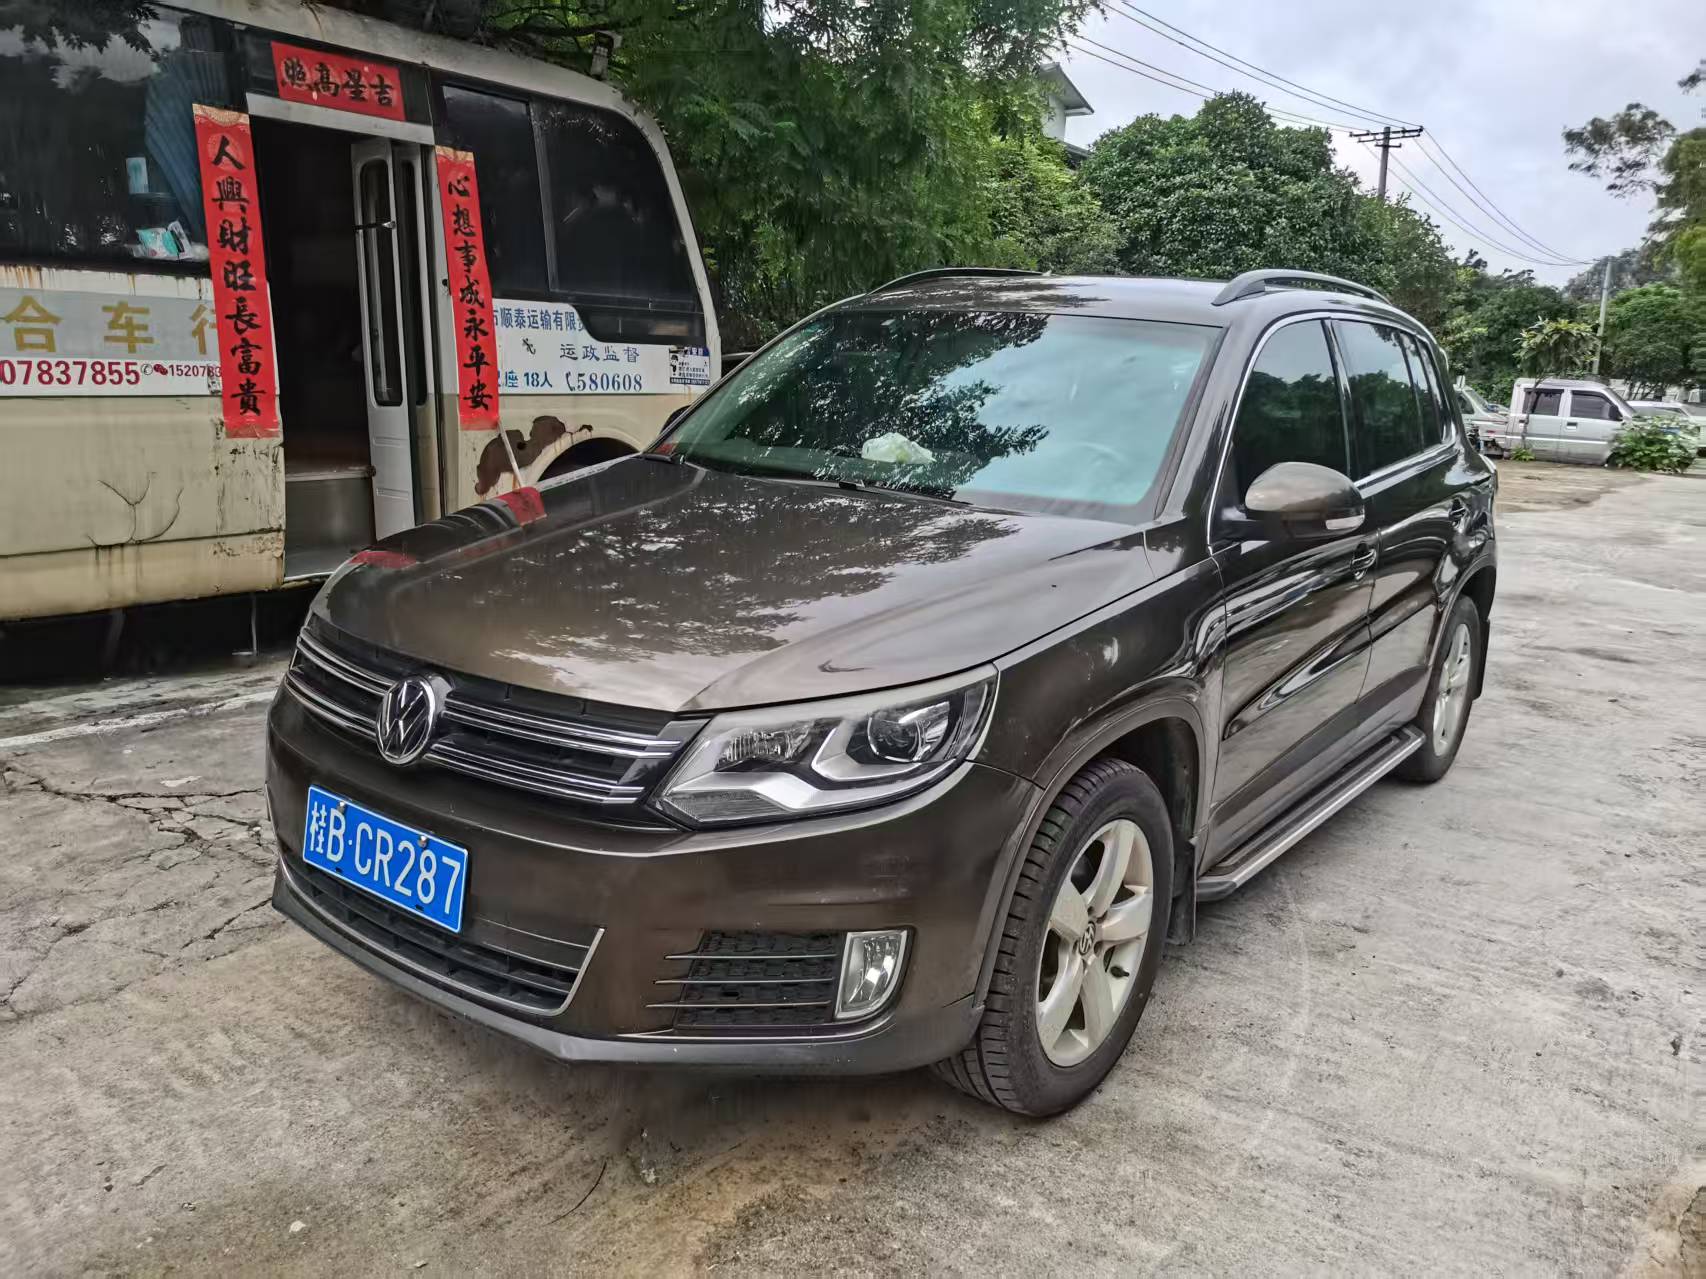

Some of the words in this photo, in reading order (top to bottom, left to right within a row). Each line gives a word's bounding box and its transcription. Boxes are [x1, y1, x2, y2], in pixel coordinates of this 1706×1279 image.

[211, 135, 267, 416] 人興財旺長富貴
[447, 175, 493, 411] 心想事成永平安
[560, 343, 640, 363] 运政监督
[524, 371, 553, 389] 18人
[577, 372, 642, 392] 580608
